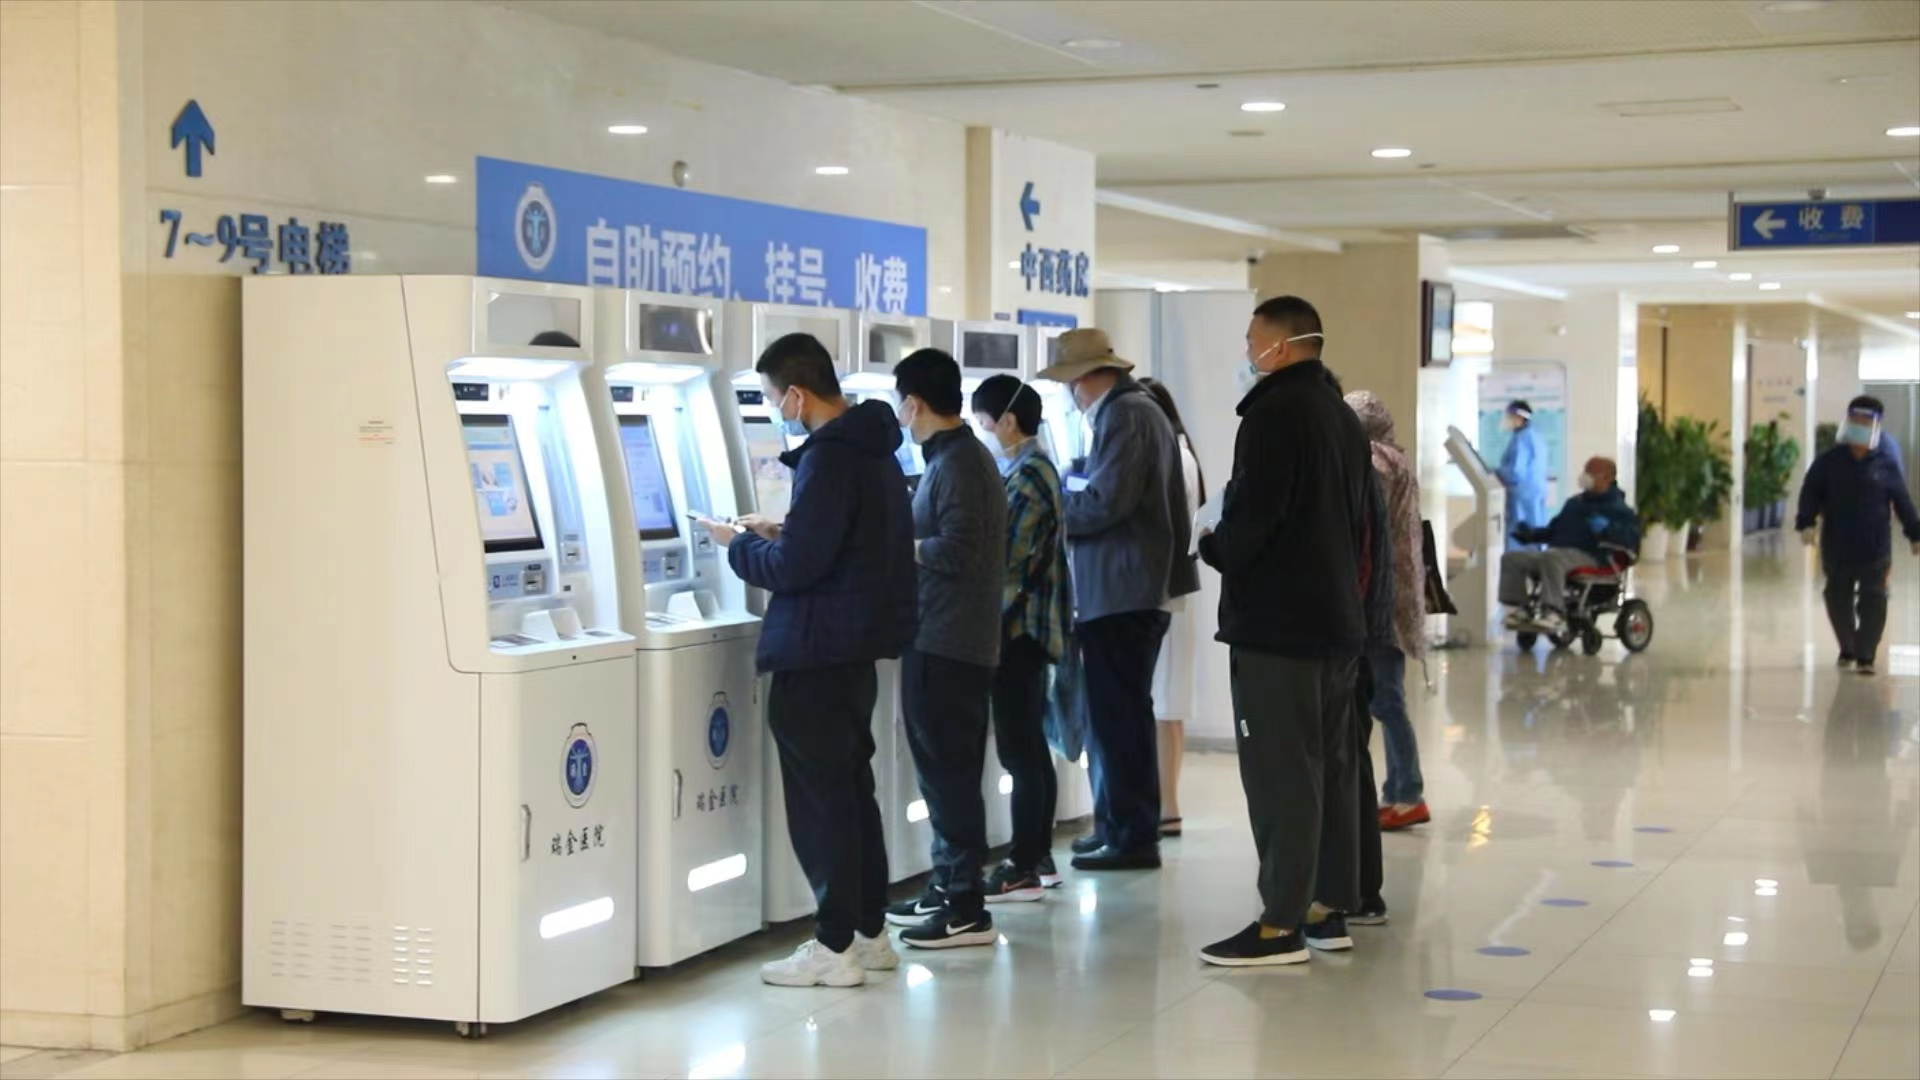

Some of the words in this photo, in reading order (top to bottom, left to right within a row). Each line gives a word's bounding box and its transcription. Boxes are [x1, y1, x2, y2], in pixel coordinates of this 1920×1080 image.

[1799, 205, 1865, 231] 收费
[1020, 242, 1089, 297] 中西药房
